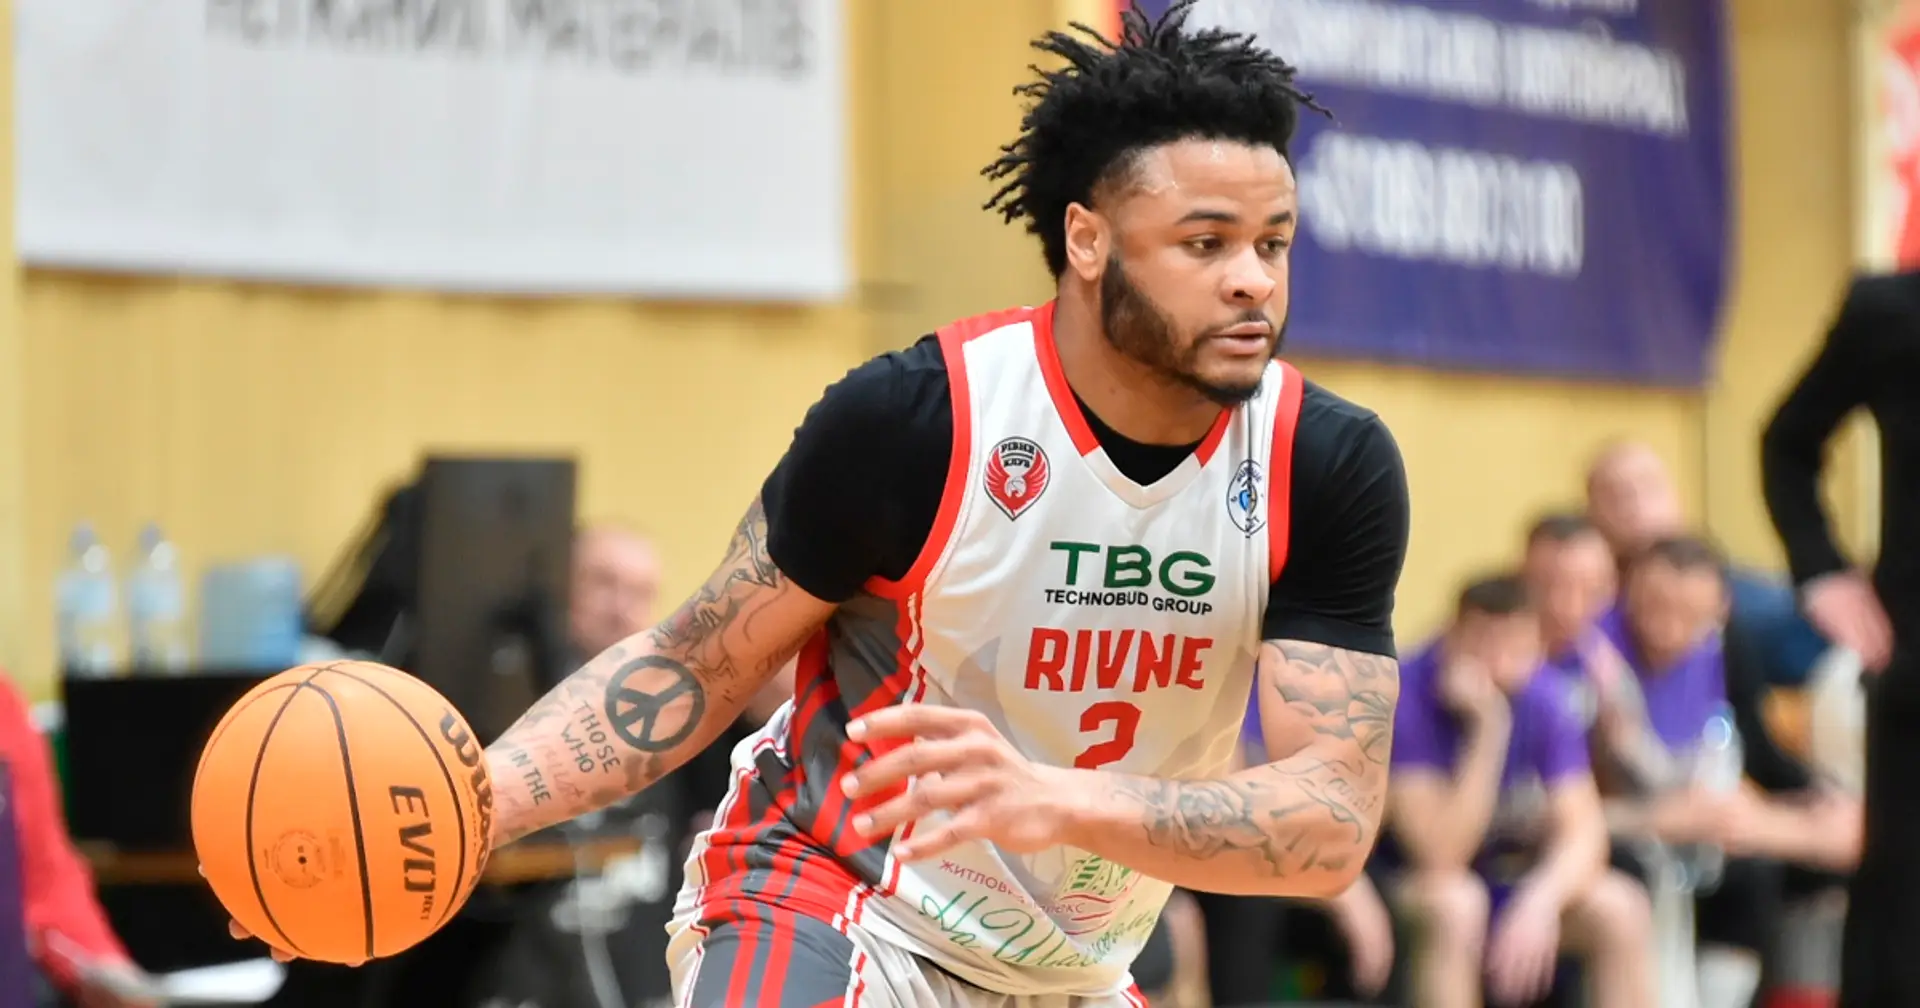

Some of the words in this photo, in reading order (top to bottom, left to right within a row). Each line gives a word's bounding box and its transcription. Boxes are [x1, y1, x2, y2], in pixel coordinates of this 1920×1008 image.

[1050, 541, 1216, 597] TBG
[1045, 588, 1149, 607] TECHNOBUD
[1152, 597, 1213, 616] GROUP
[1023, 627, 1213, 693] RIVNE
[560, 722, 595, 773] WHO
[574, 699, 621, 774] THOSE
[1073, 700, 1143, 771] 2
[509, 749, 533, 768] IN
[523, 766, 551, 806] THE
[388, 784, 437, 893] EVO
[939, 859, 1026, 905] ЖИТЛОВ
